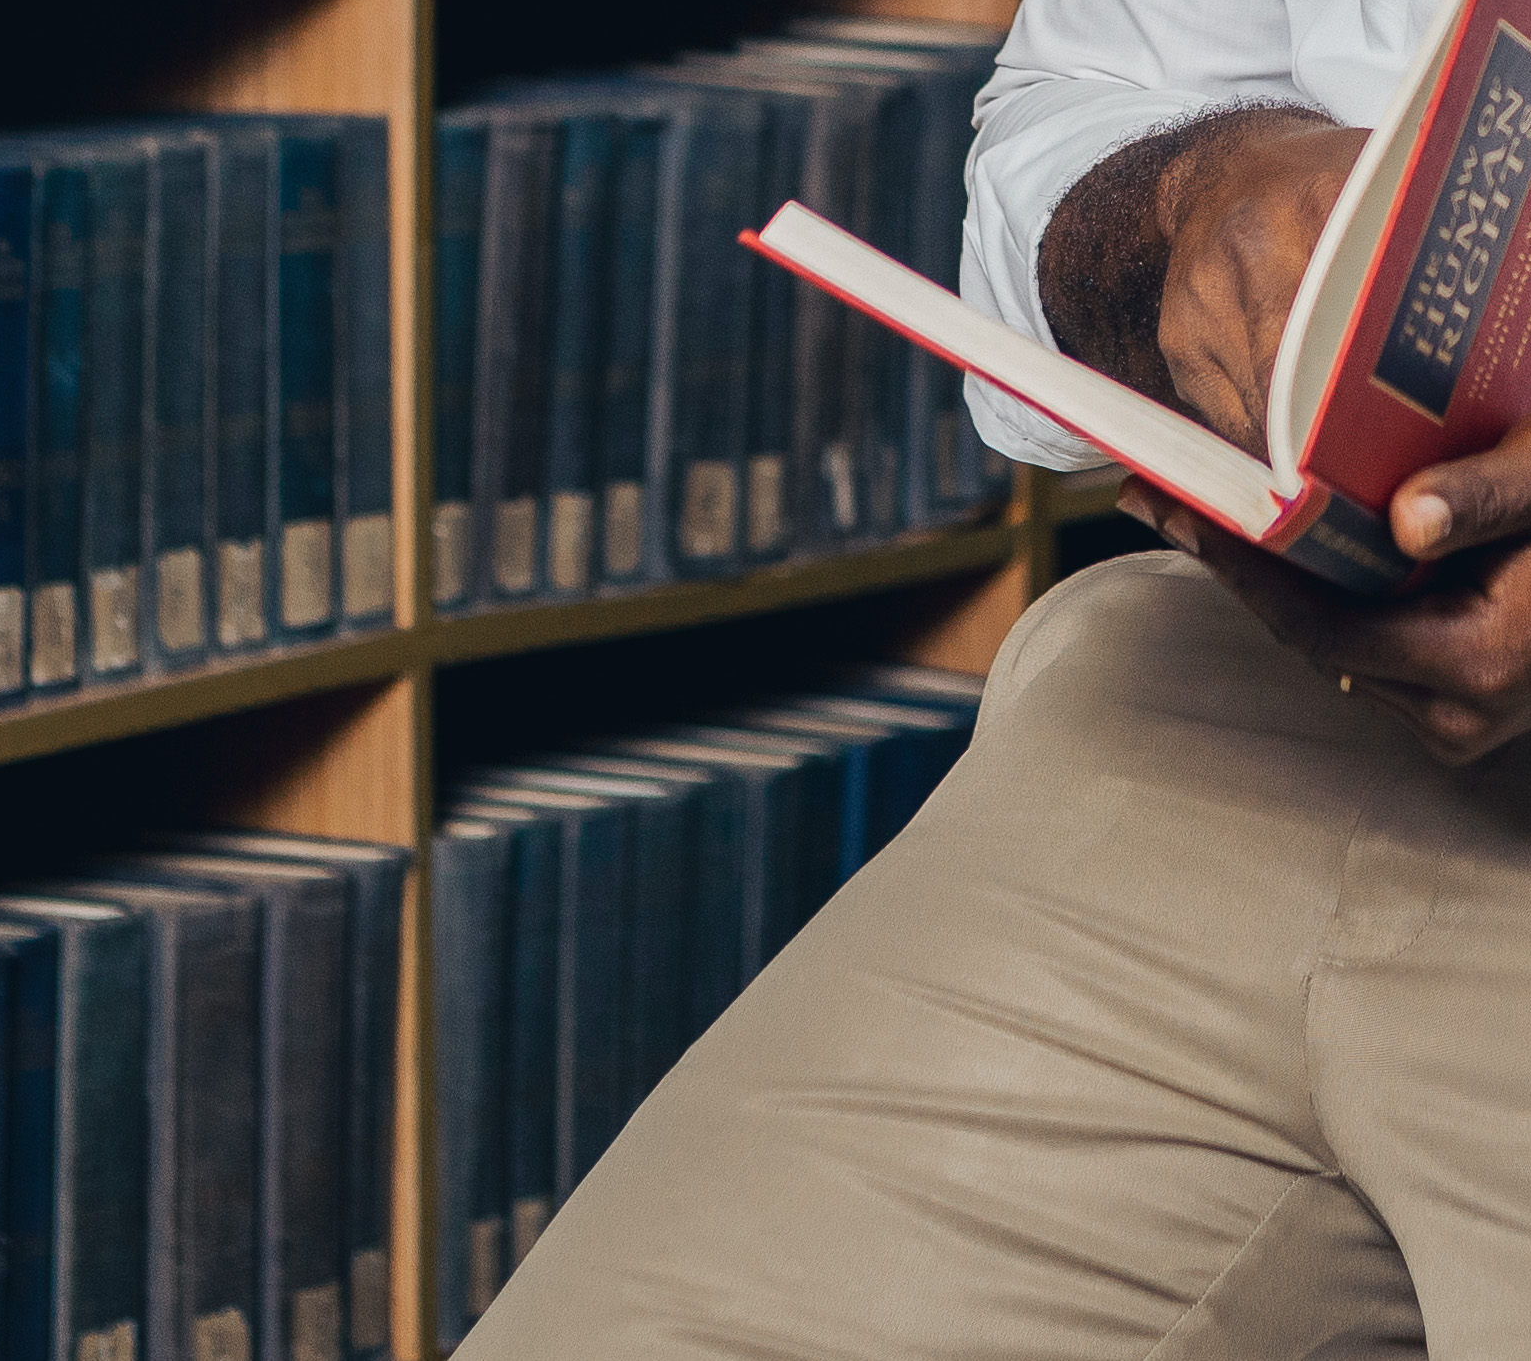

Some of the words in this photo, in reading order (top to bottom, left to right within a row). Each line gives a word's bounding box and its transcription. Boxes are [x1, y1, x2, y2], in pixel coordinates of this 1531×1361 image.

[1414, 86, 1524, 357] HUMAN
[1438, 145, 1479, 242] LAW
[1477, 76, 1503, 138] OF
